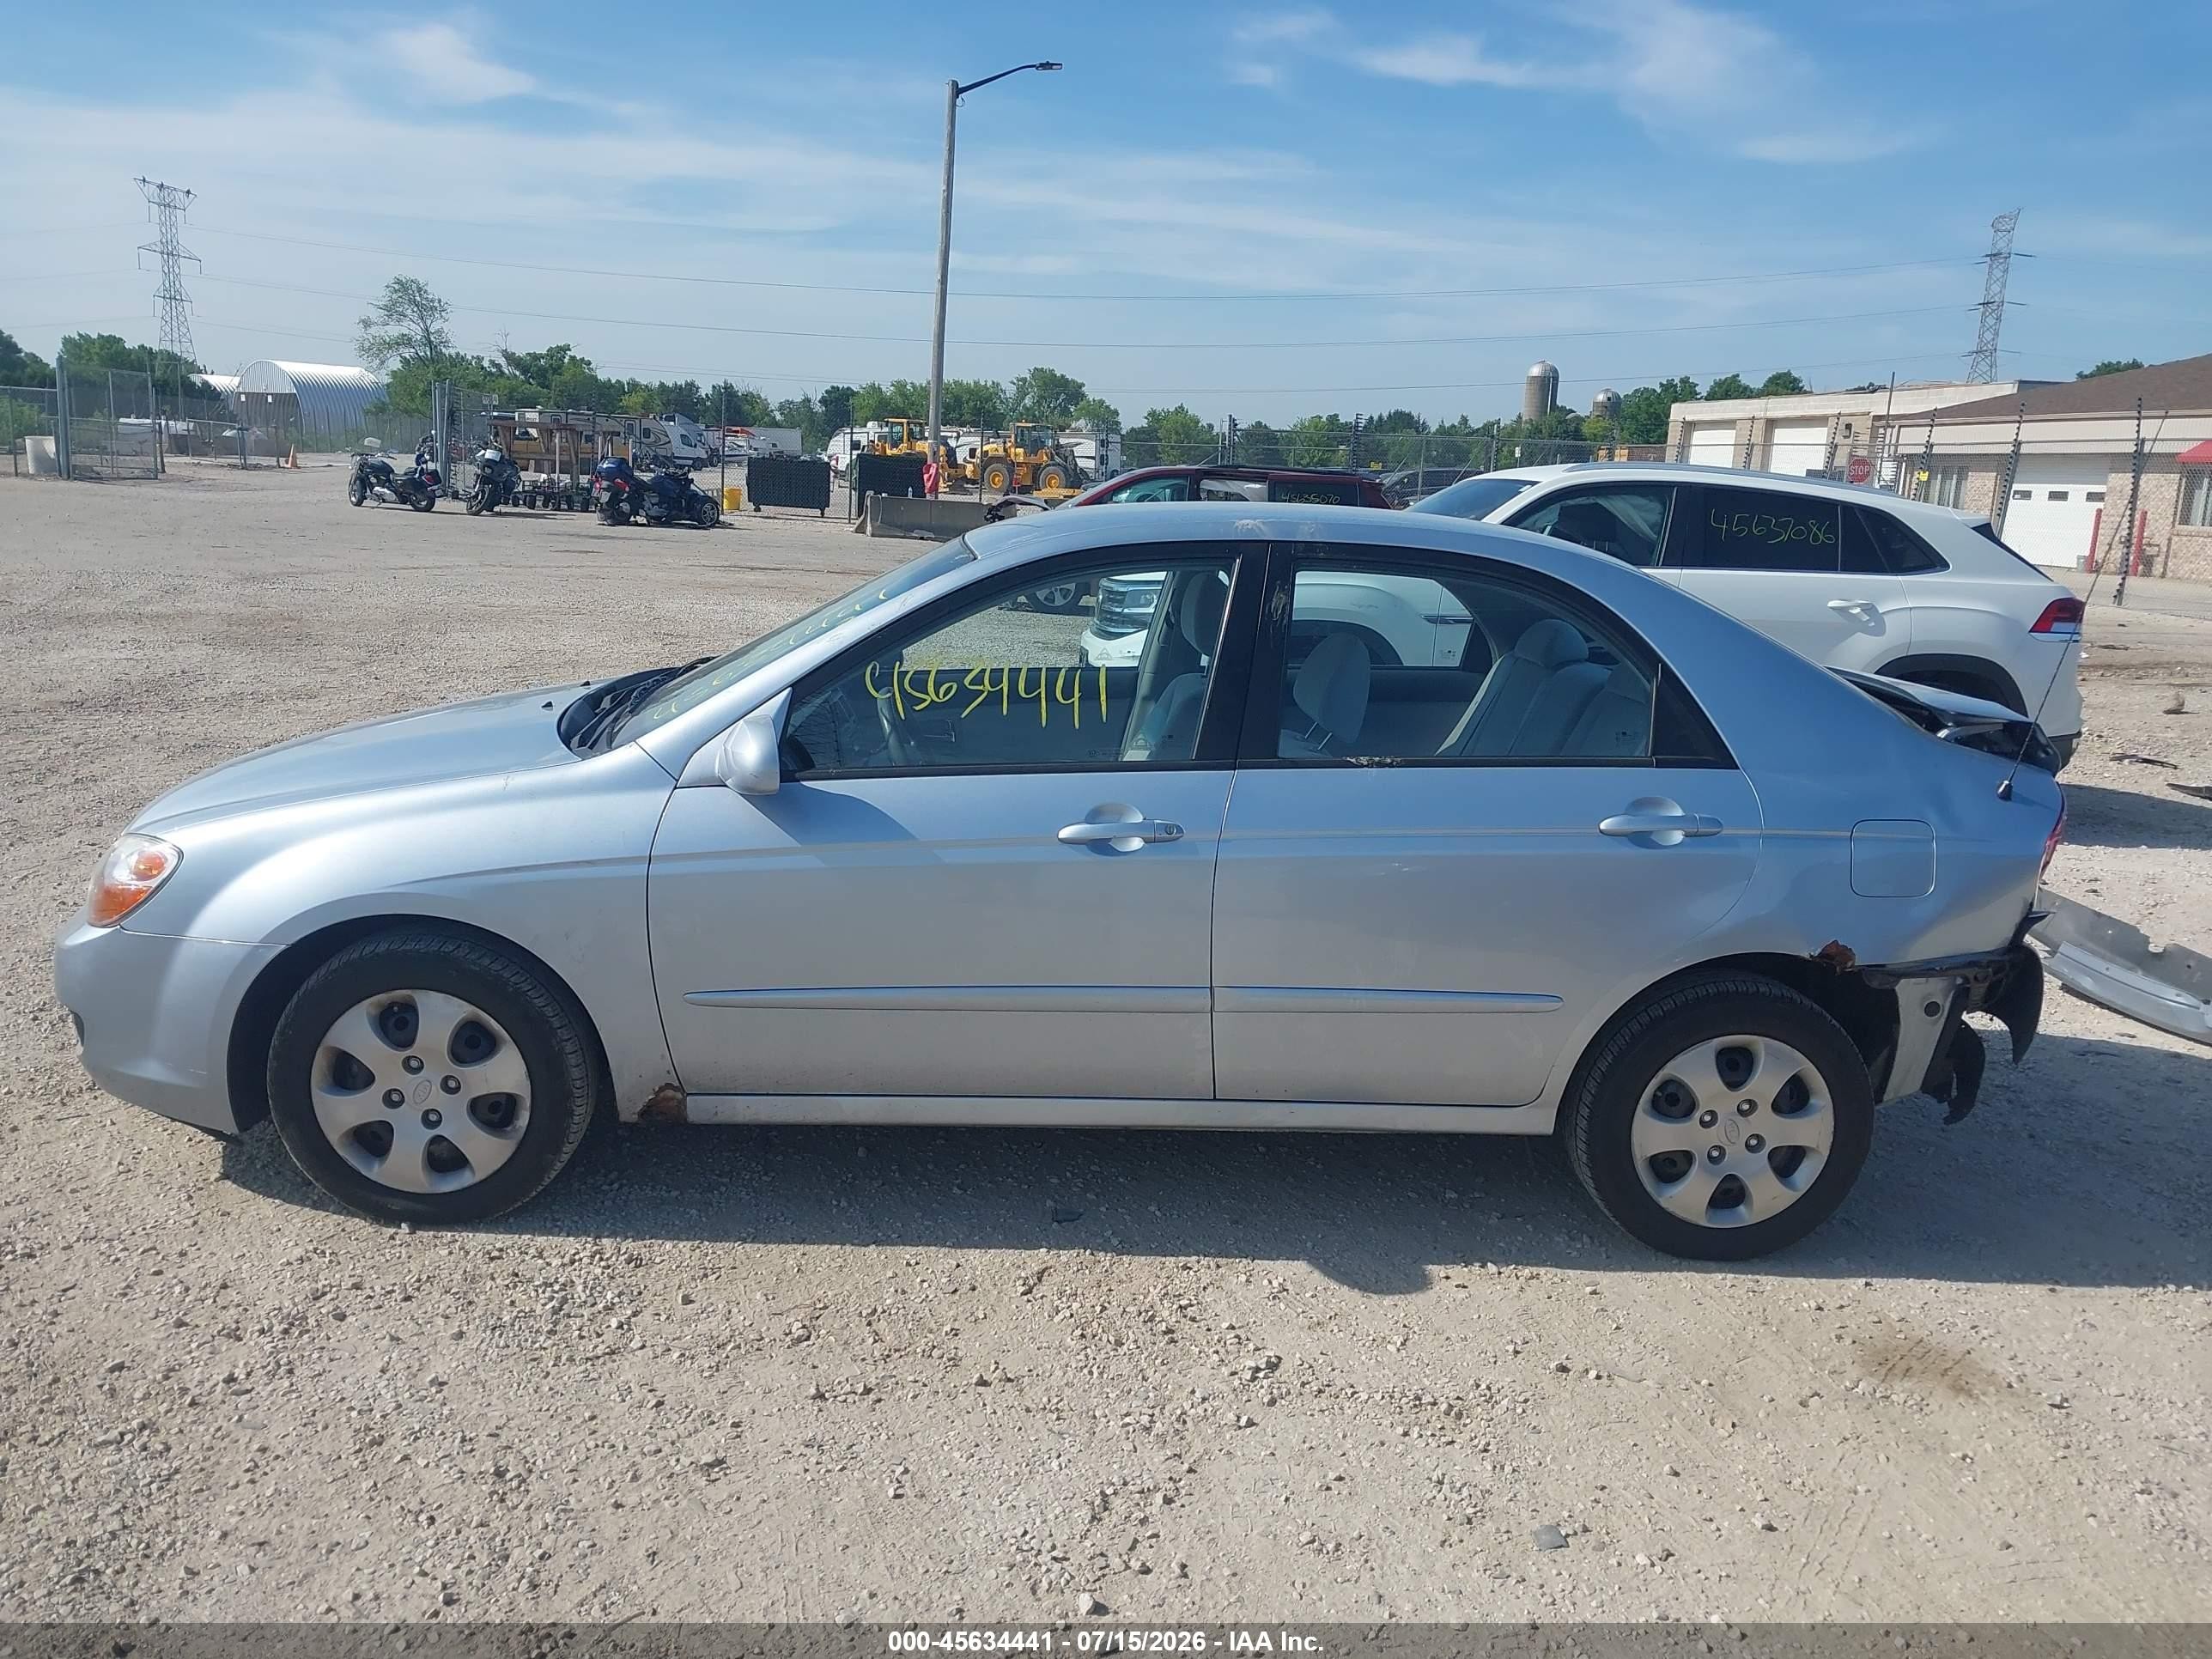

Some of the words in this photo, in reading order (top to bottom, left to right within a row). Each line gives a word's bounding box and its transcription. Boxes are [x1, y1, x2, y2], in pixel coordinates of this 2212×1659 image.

[1850, 465, 1870, 476] STOP
[1710, 508, 1836, 545] 45637086
[865, 661, 1108, 729] 45634441
